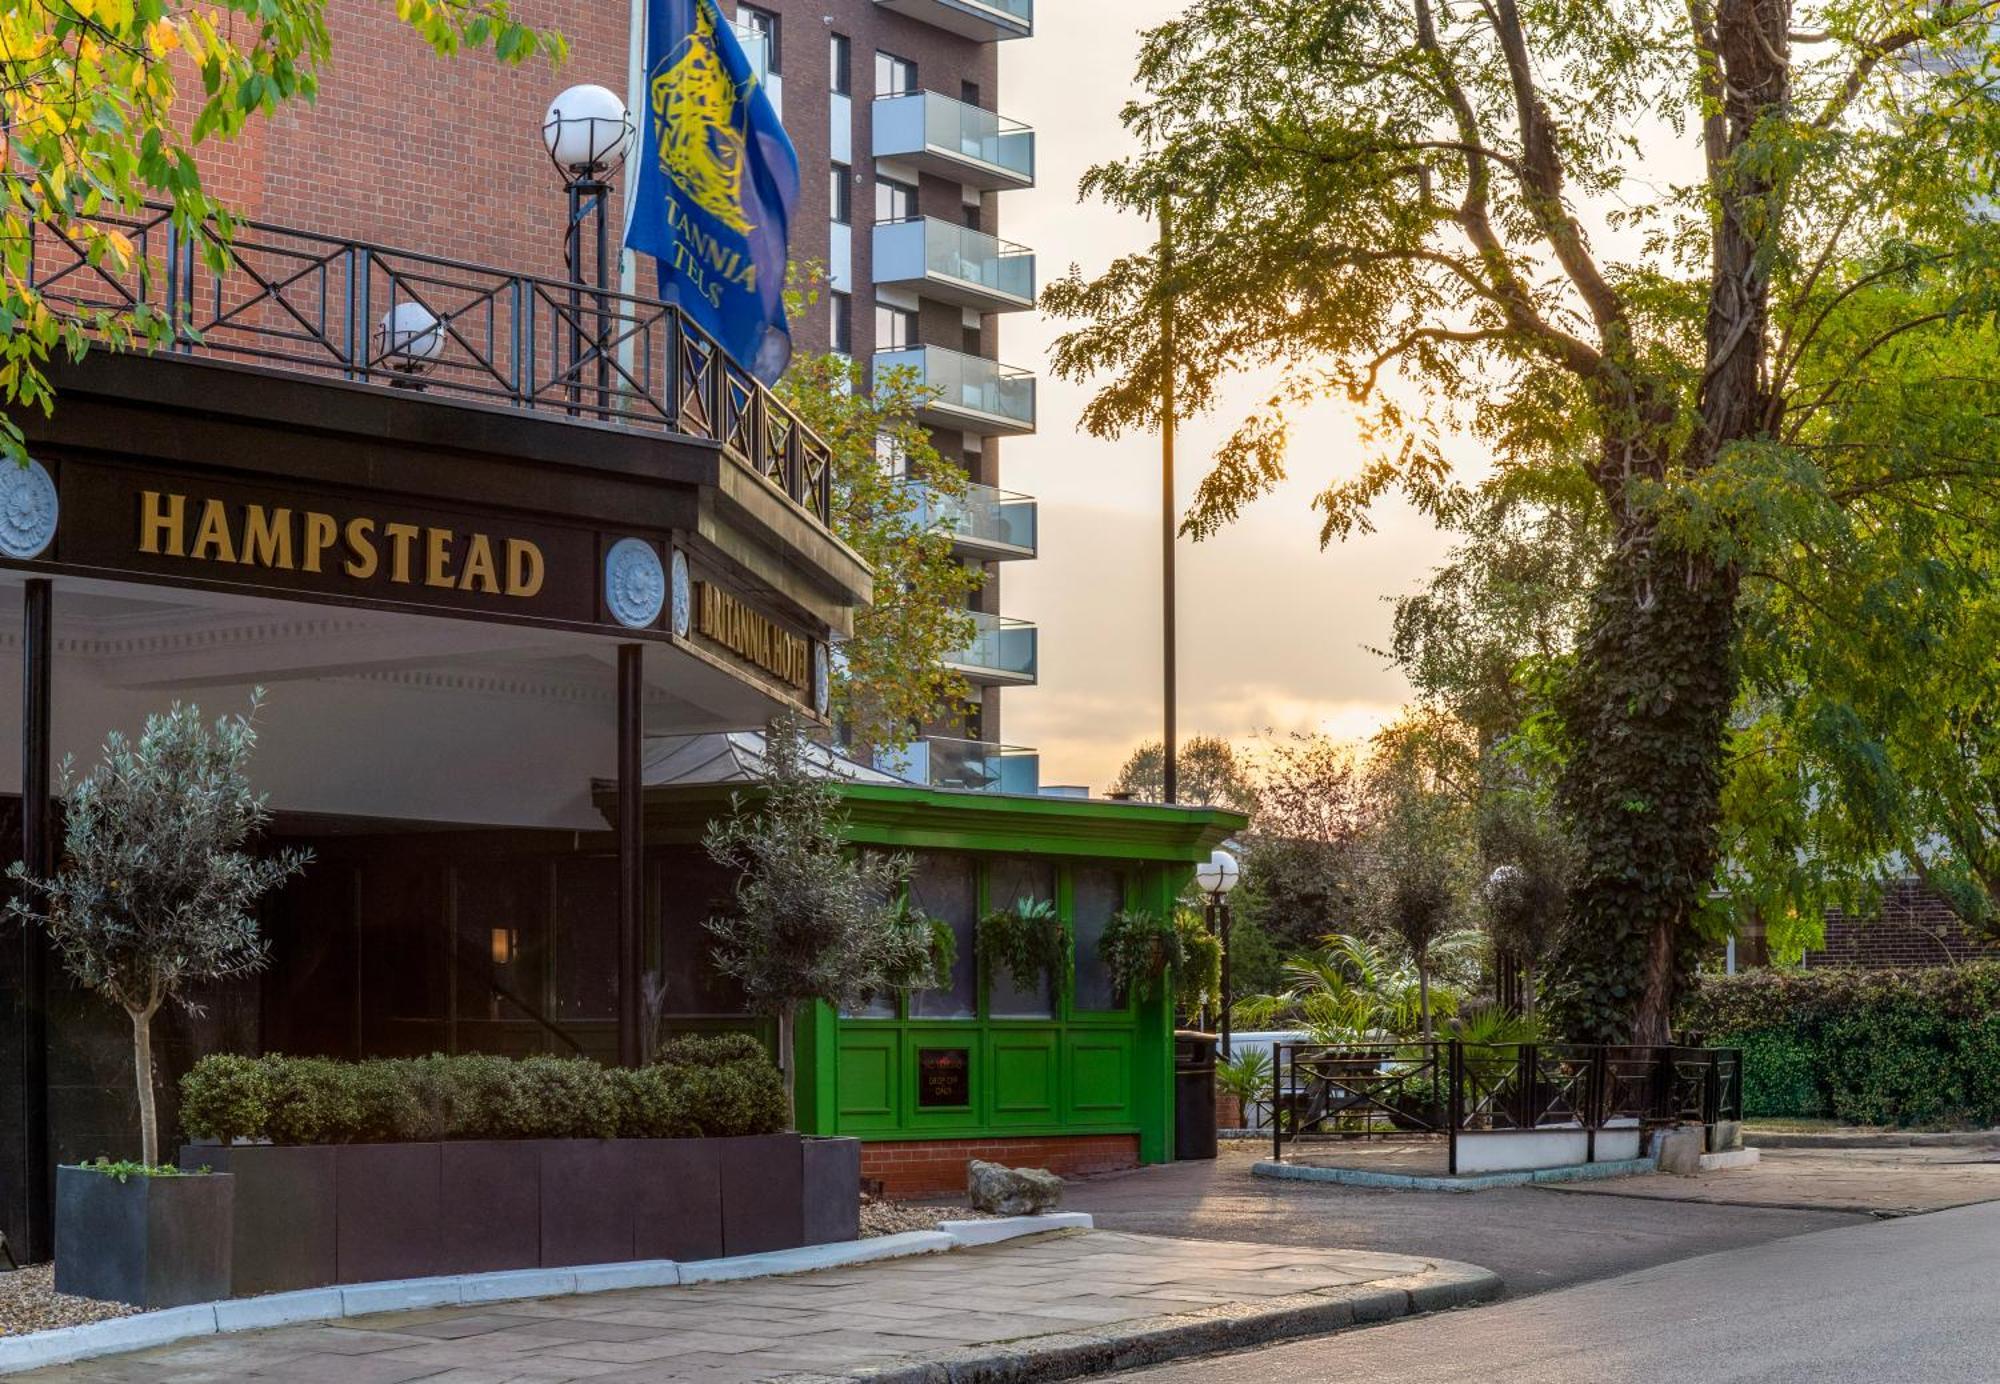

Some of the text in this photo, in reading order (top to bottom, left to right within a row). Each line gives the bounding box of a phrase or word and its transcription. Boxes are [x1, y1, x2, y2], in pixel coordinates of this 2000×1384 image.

[138, 490, 545, 598] HAMPSTEAD
[702, 580, 809, 692] BRITANNIA HOTEL
